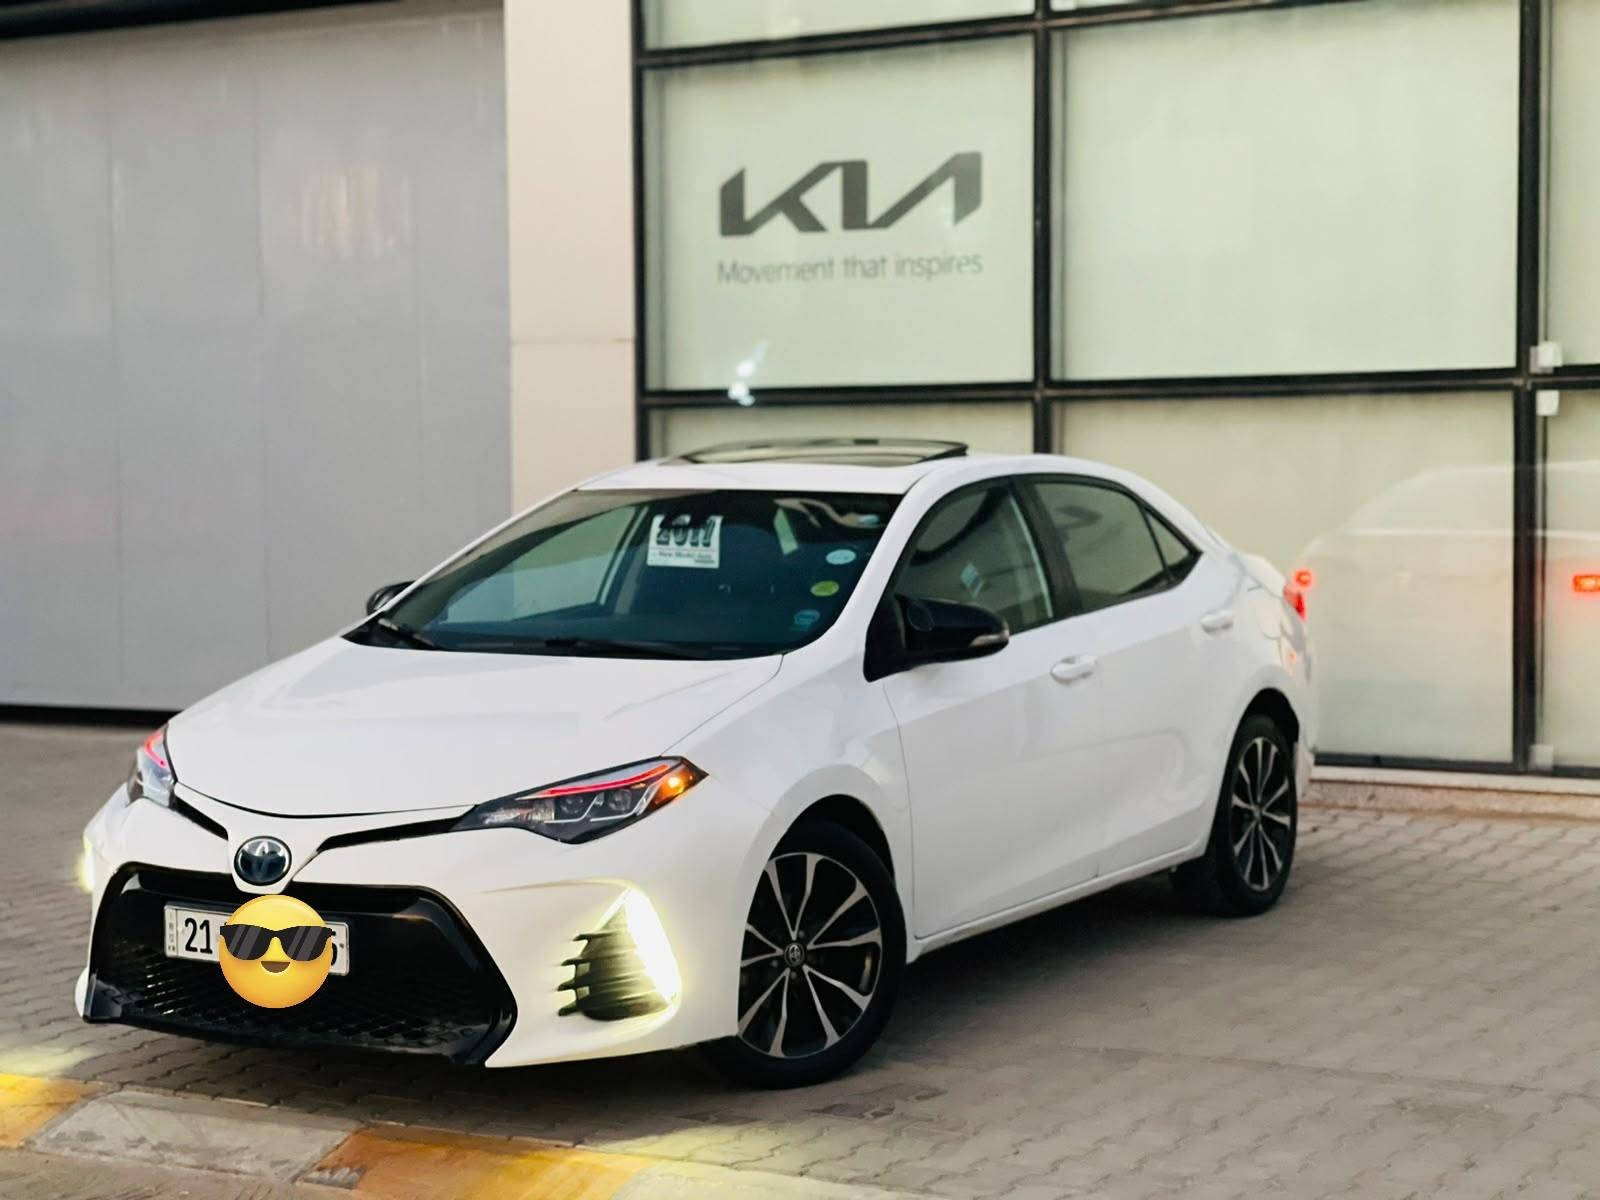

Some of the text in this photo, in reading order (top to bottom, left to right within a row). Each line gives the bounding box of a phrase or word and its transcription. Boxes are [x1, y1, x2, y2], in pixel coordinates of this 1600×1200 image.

[719, 151, 983, 237] KIA
[717, 252, 984, 284] Movement that inspires
[185, 917, 213, 954] 21
